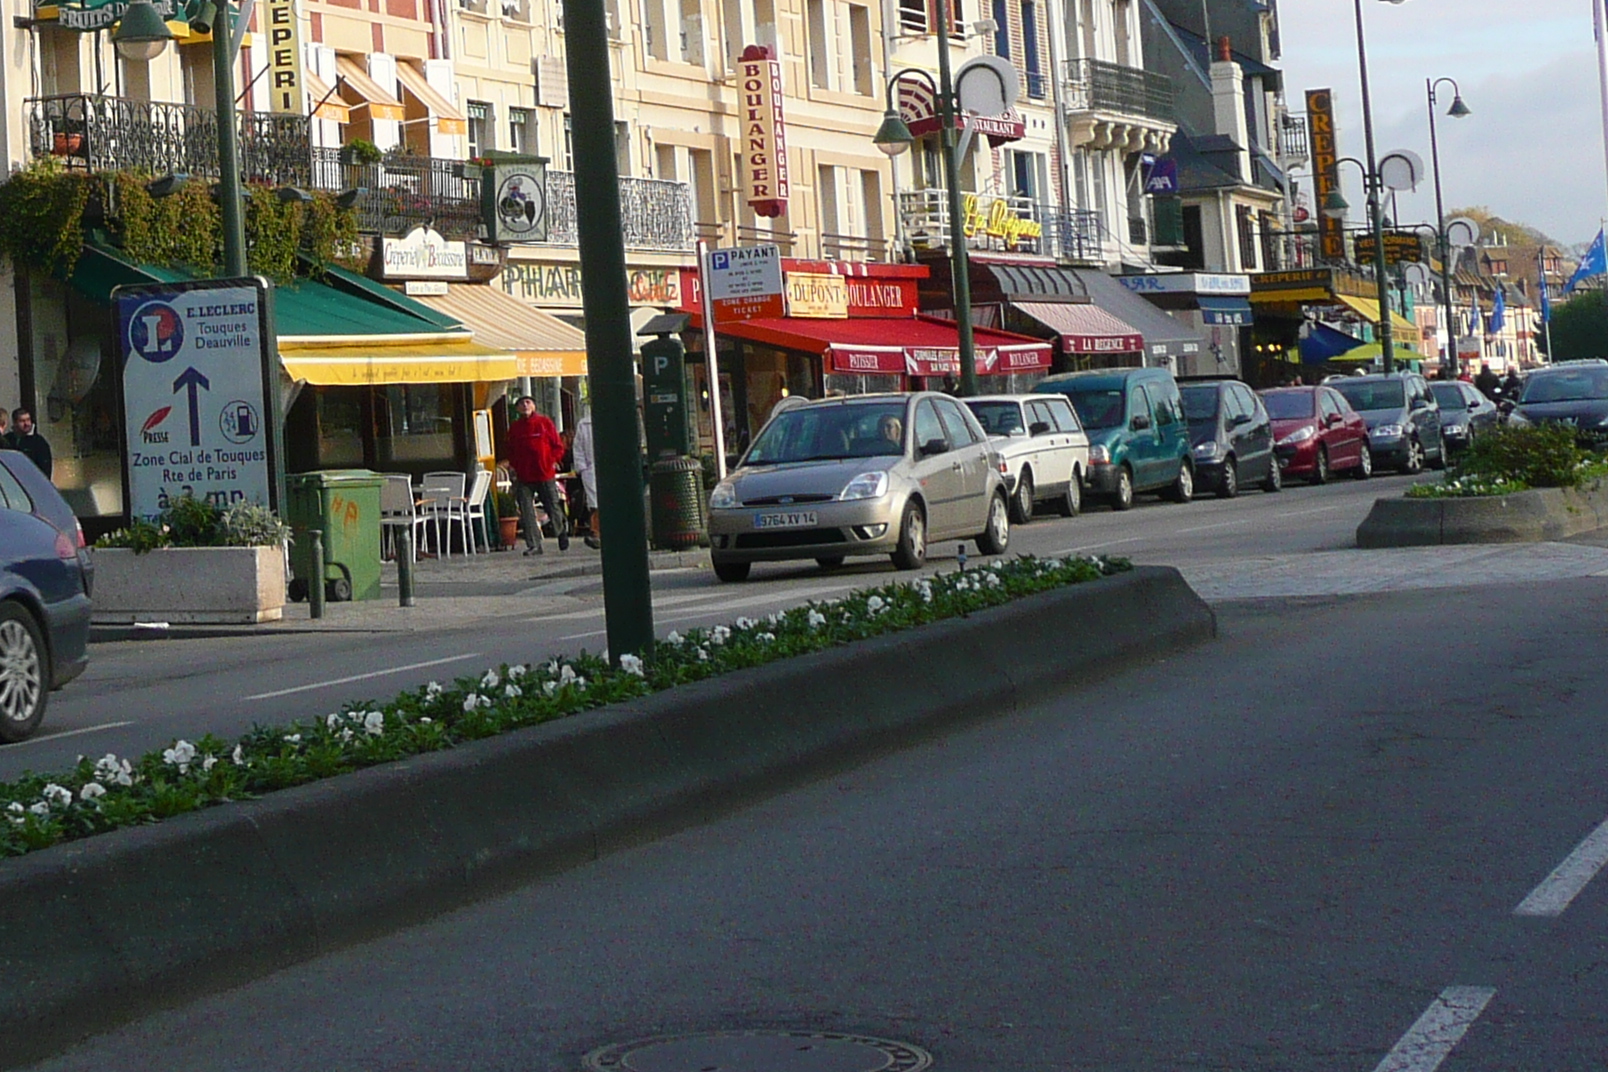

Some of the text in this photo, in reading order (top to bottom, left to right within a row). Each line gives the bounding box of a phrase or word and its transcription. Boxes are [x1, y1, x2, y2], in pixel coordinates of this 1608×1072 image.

[58, 2, 114, 26] FRUITS
[744, 64, 770, 197] BOULANGER
[771, 63, 787, 197] BOULANGER
[1146, 176, 1172, 190] AXA
[730, 248, 776, 260] PAYANT
[794, 283, 840, 303] DUPONT
[197, 322, 247, 335] Touques
[195, 335, 250, 349] Deauville
[654, 357, 668, 375] P
[133, 452, 165, 467] Zone
[197, 450, 212, 464] de
[214, 448, 266, 465] Touques
[163, 466, 237, 482] Rte de Paris
[761, 516, 785, 526] 9764
[787, 514, 800, 525] XV
